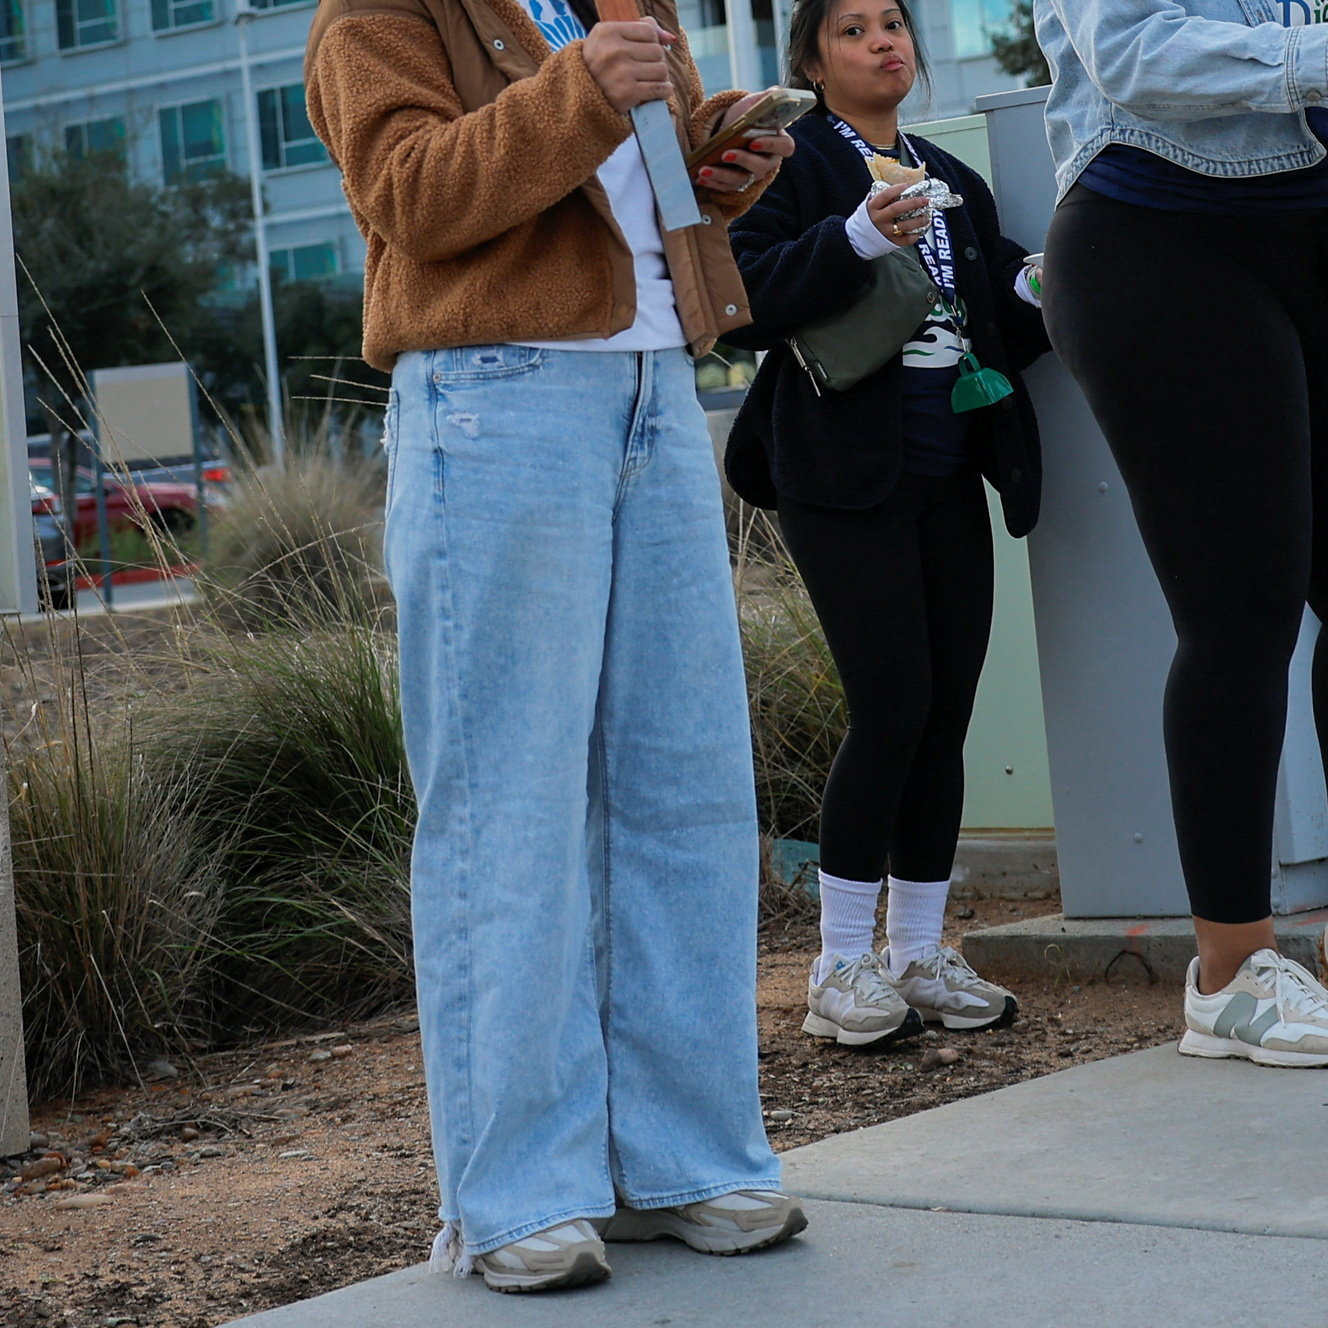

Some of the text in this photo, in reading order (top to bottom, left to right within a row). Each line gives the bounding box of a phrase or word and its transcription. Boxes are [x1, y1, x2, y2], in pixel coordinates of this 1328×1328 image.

[833, 120, 854, 139] I'M
[932, 209, 952, 260] READY
[941, 264, 955, 289] I'M
